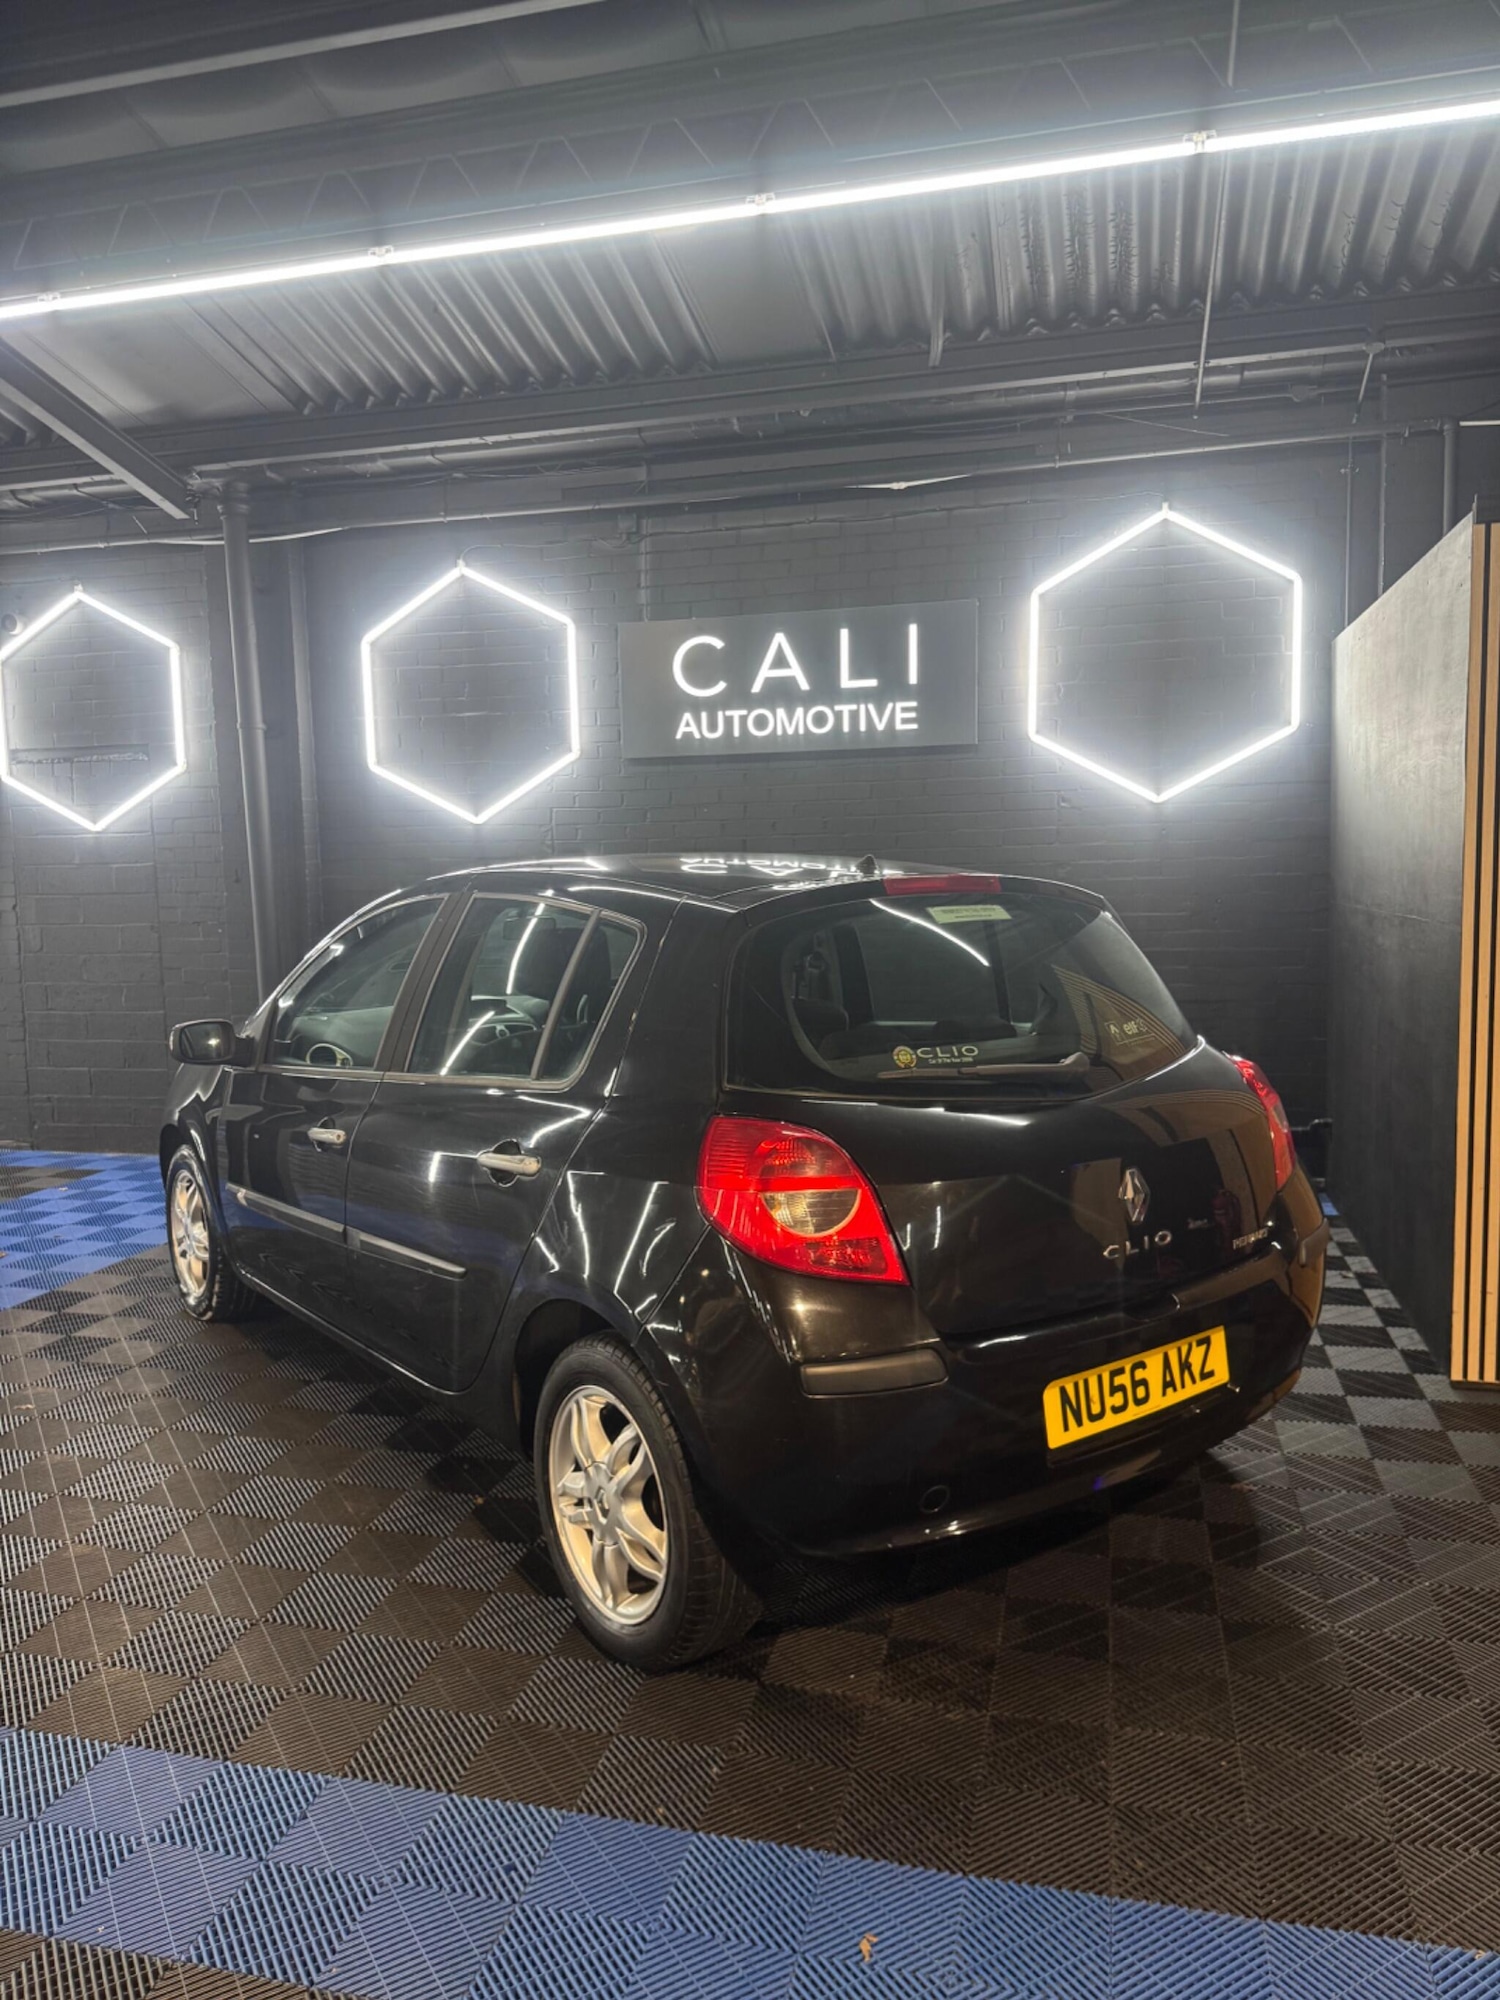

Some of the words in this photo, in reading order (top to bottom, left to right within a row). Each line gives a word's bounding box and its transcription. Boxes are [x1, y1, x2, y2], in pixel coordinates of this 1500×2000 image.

[672, 623, 918, 698] CALI
[675, 701, 919, 739] AUTOMOTIVE
[916, 1045, 979, 1058] CLIO
[1102, 1230, 1173, 1260] CLIO
[1058, 1360, 1151, 1433] NU56
[1161, 1335, 1216, 1398] AKZ
